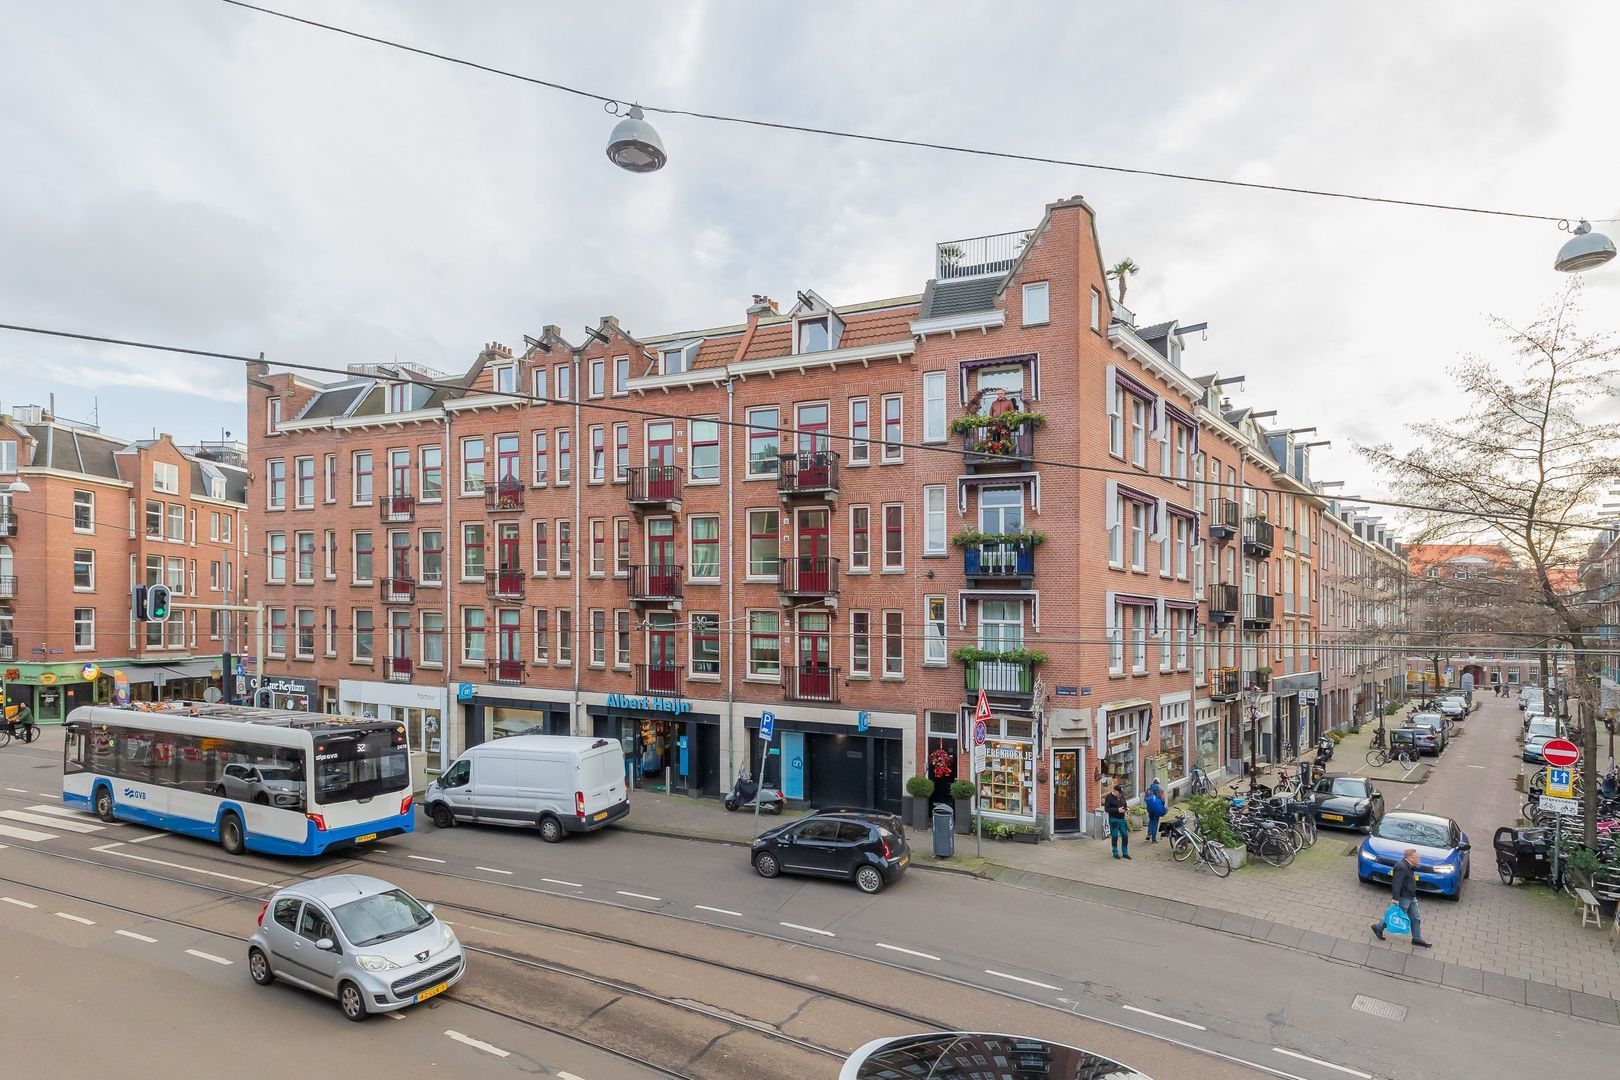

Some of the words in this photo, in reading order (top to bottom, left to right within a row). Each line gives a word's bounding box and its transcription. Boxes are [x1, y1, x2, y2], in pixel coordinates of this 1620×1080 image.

[607, 693, 649, 710] Albert
[653, 697, 690, 715] Heijn
[764, 714, 771, 726] P
[985, 748, 1032, 760] ERENHOEKJE
[134, 790, 146, 800] GVB
